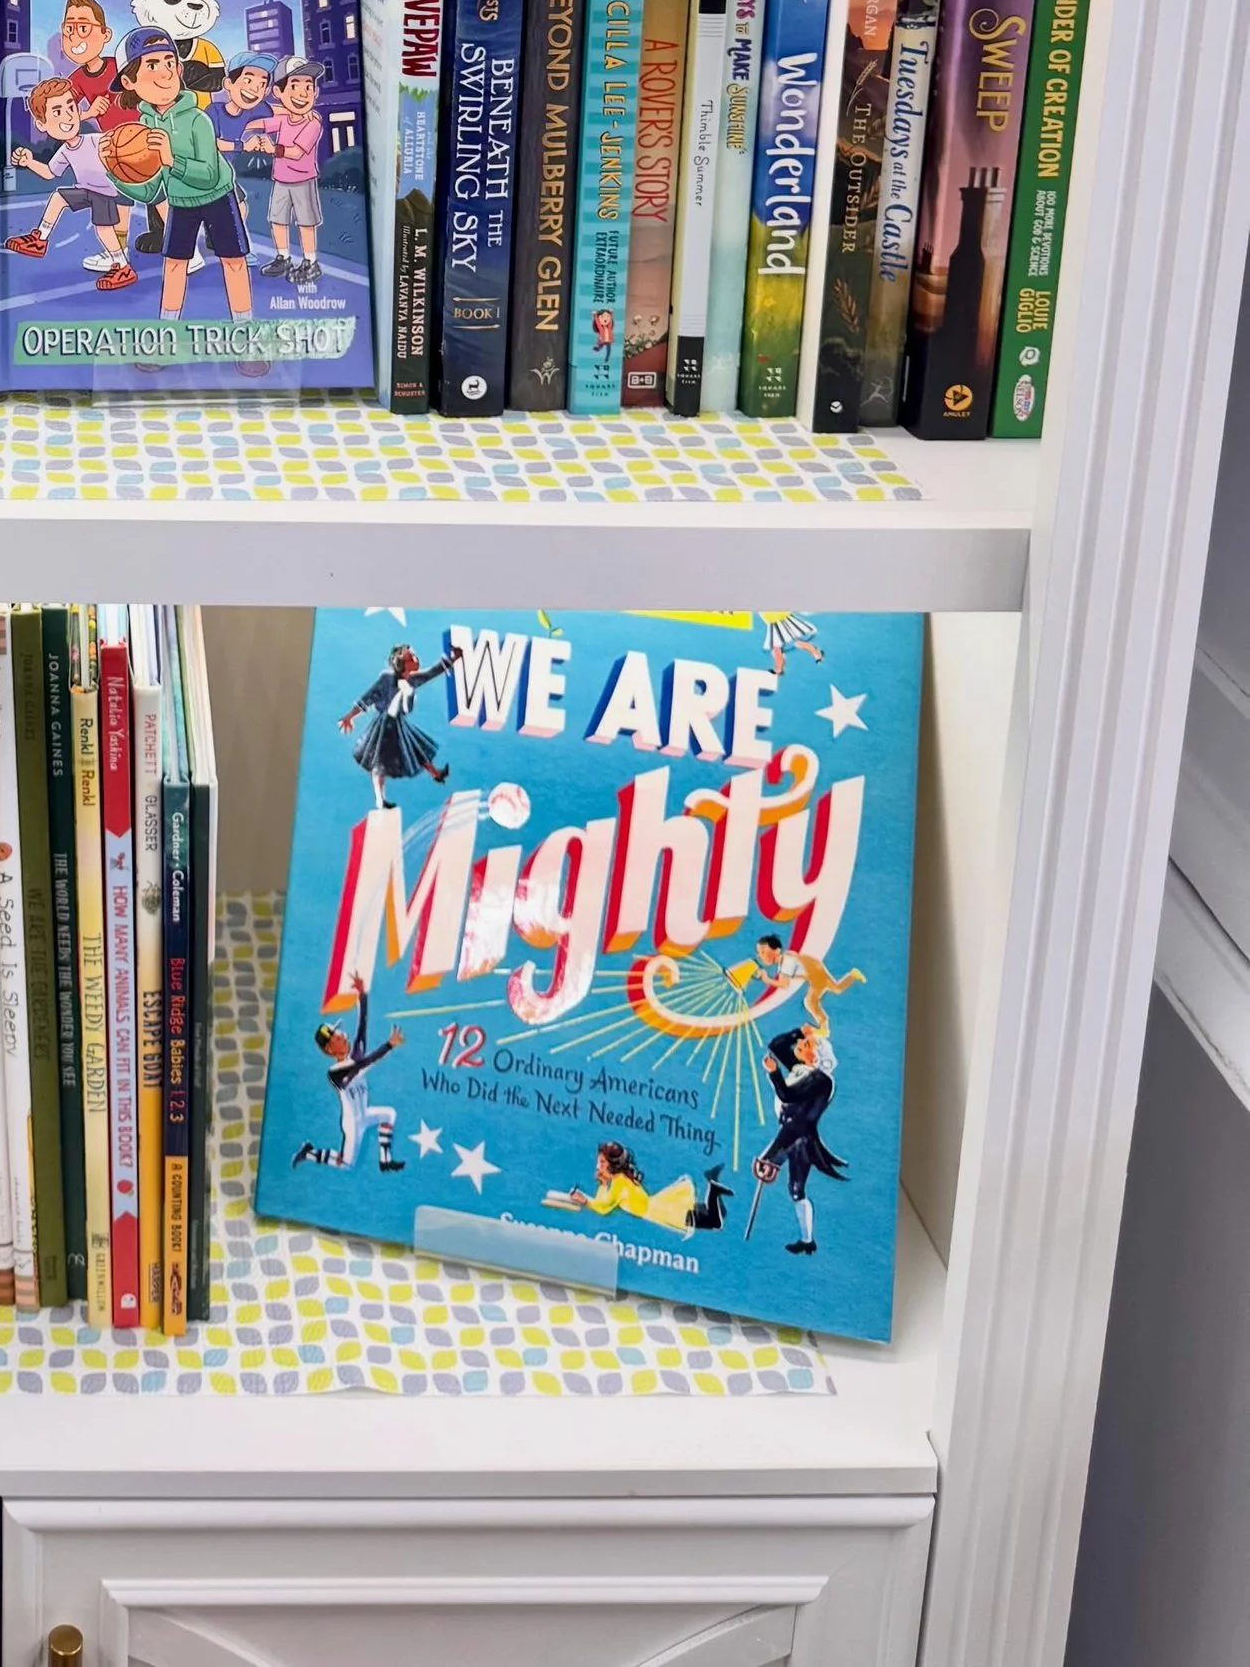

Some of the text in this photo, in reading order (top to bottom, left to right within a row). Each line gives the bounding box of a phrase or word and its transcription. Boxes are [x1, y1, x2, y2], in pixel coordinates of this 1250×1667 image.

[1047, 49, 1072, 75] OF
[757, 51, 819, 276] Wonderland
[1037, 78, 1068, 178] CREATION
[538, 103, 570, 247] MULBERRY
[269, 295, 347, 310] Allan Woodrow
[534, 255, 563, 332] GLEN
[21, 320, 348, 361] OPERATION TRICK SHOT
[443, 625, 780, 769] WE ARE
[321, 745, 866, 1040] Mighty
[438, 1024, 700, 1110] 12 Ordinary Americans
[421, 1068, 720, 1155] Who Did the Next Needed Thing
